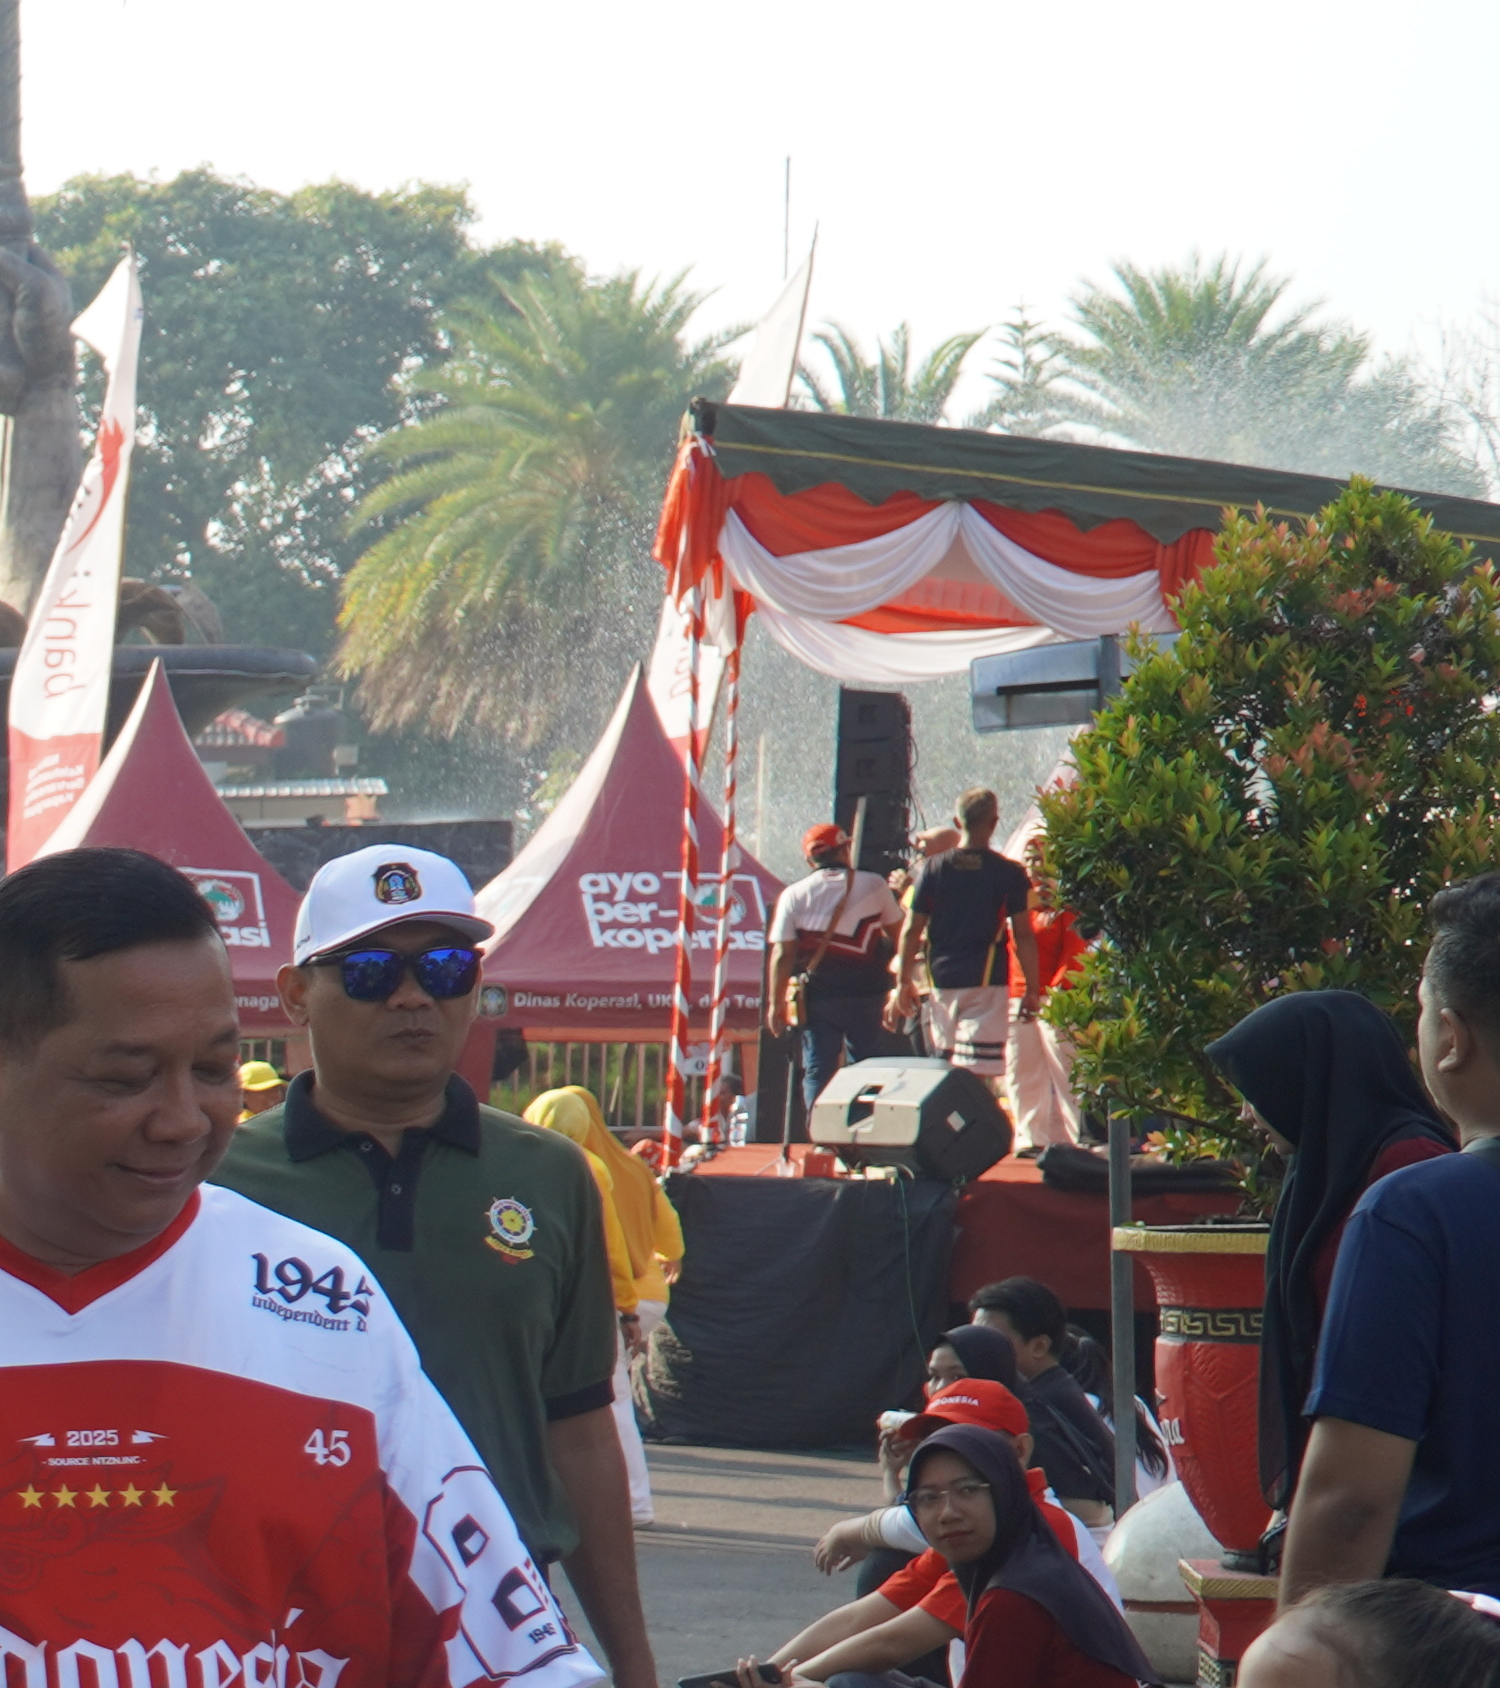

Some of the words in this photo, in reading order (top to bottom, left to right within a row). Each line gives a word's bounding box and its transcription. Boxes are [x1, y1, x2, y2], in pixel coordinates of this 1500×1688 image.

[578, 871, 660, 901] ayo
[513, 992, 561, 1008] Dinas
[66, 1429, 119, 1447] 2025
[303, 1427, 352, 1467] 45
